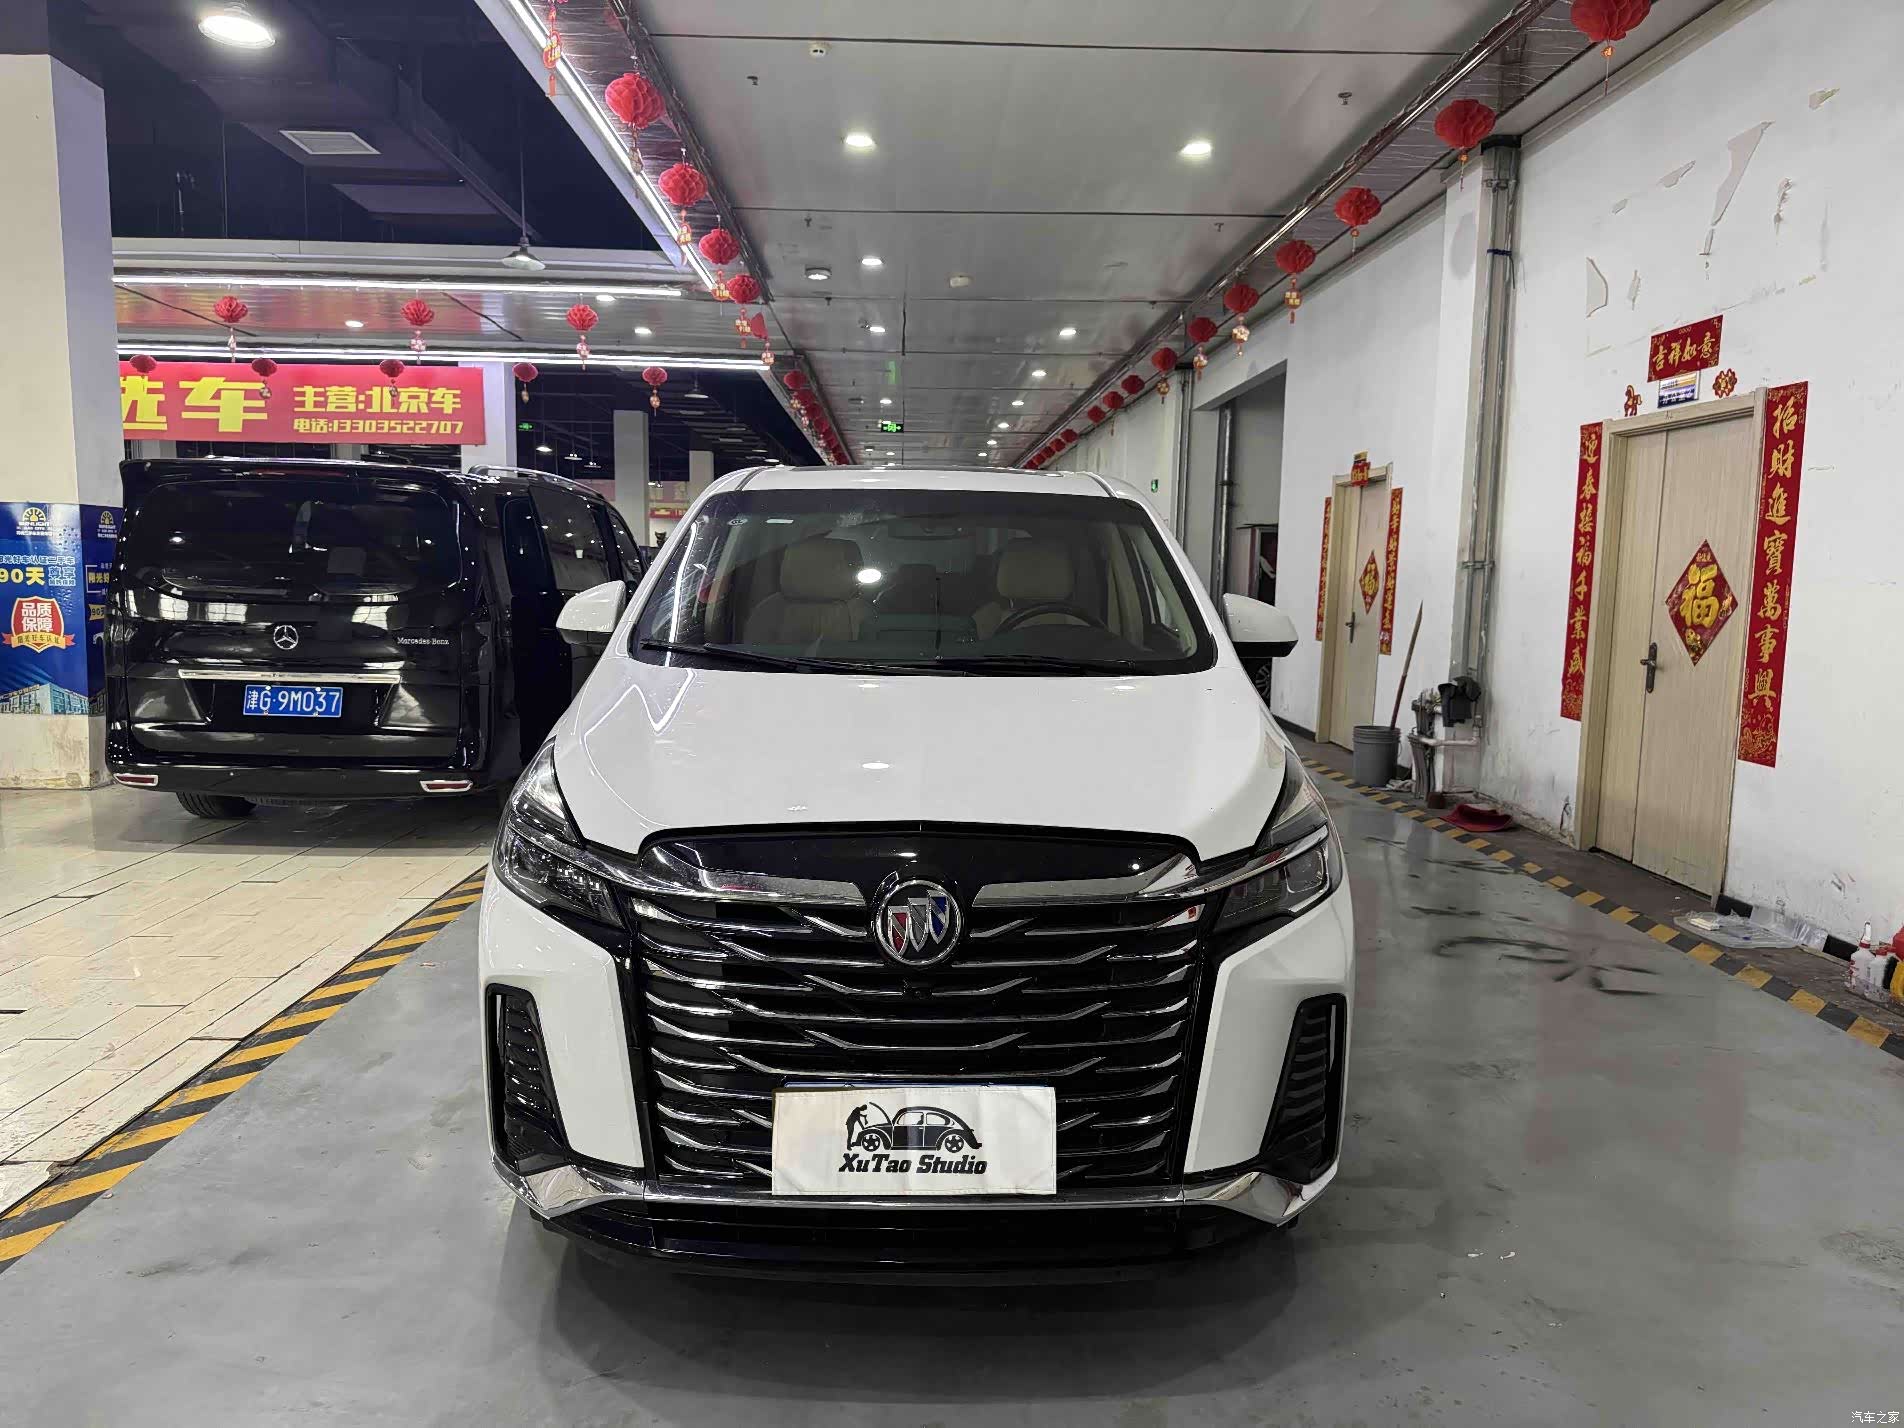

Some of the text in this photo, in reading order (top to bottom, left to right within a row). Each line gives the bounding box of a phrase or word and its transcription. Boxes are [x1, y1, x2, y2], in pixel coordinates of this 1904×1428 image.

[1652, 331, 1716, 371] 吉祥如意
[0, 567, 46, 585] 90天
[1679, 563, 1719, 628] 福
[21, 602, 52, 617] 品质
[22, 616, 54, 632] 保障
[838, 1152, 989, 1175] XuTao Studio
